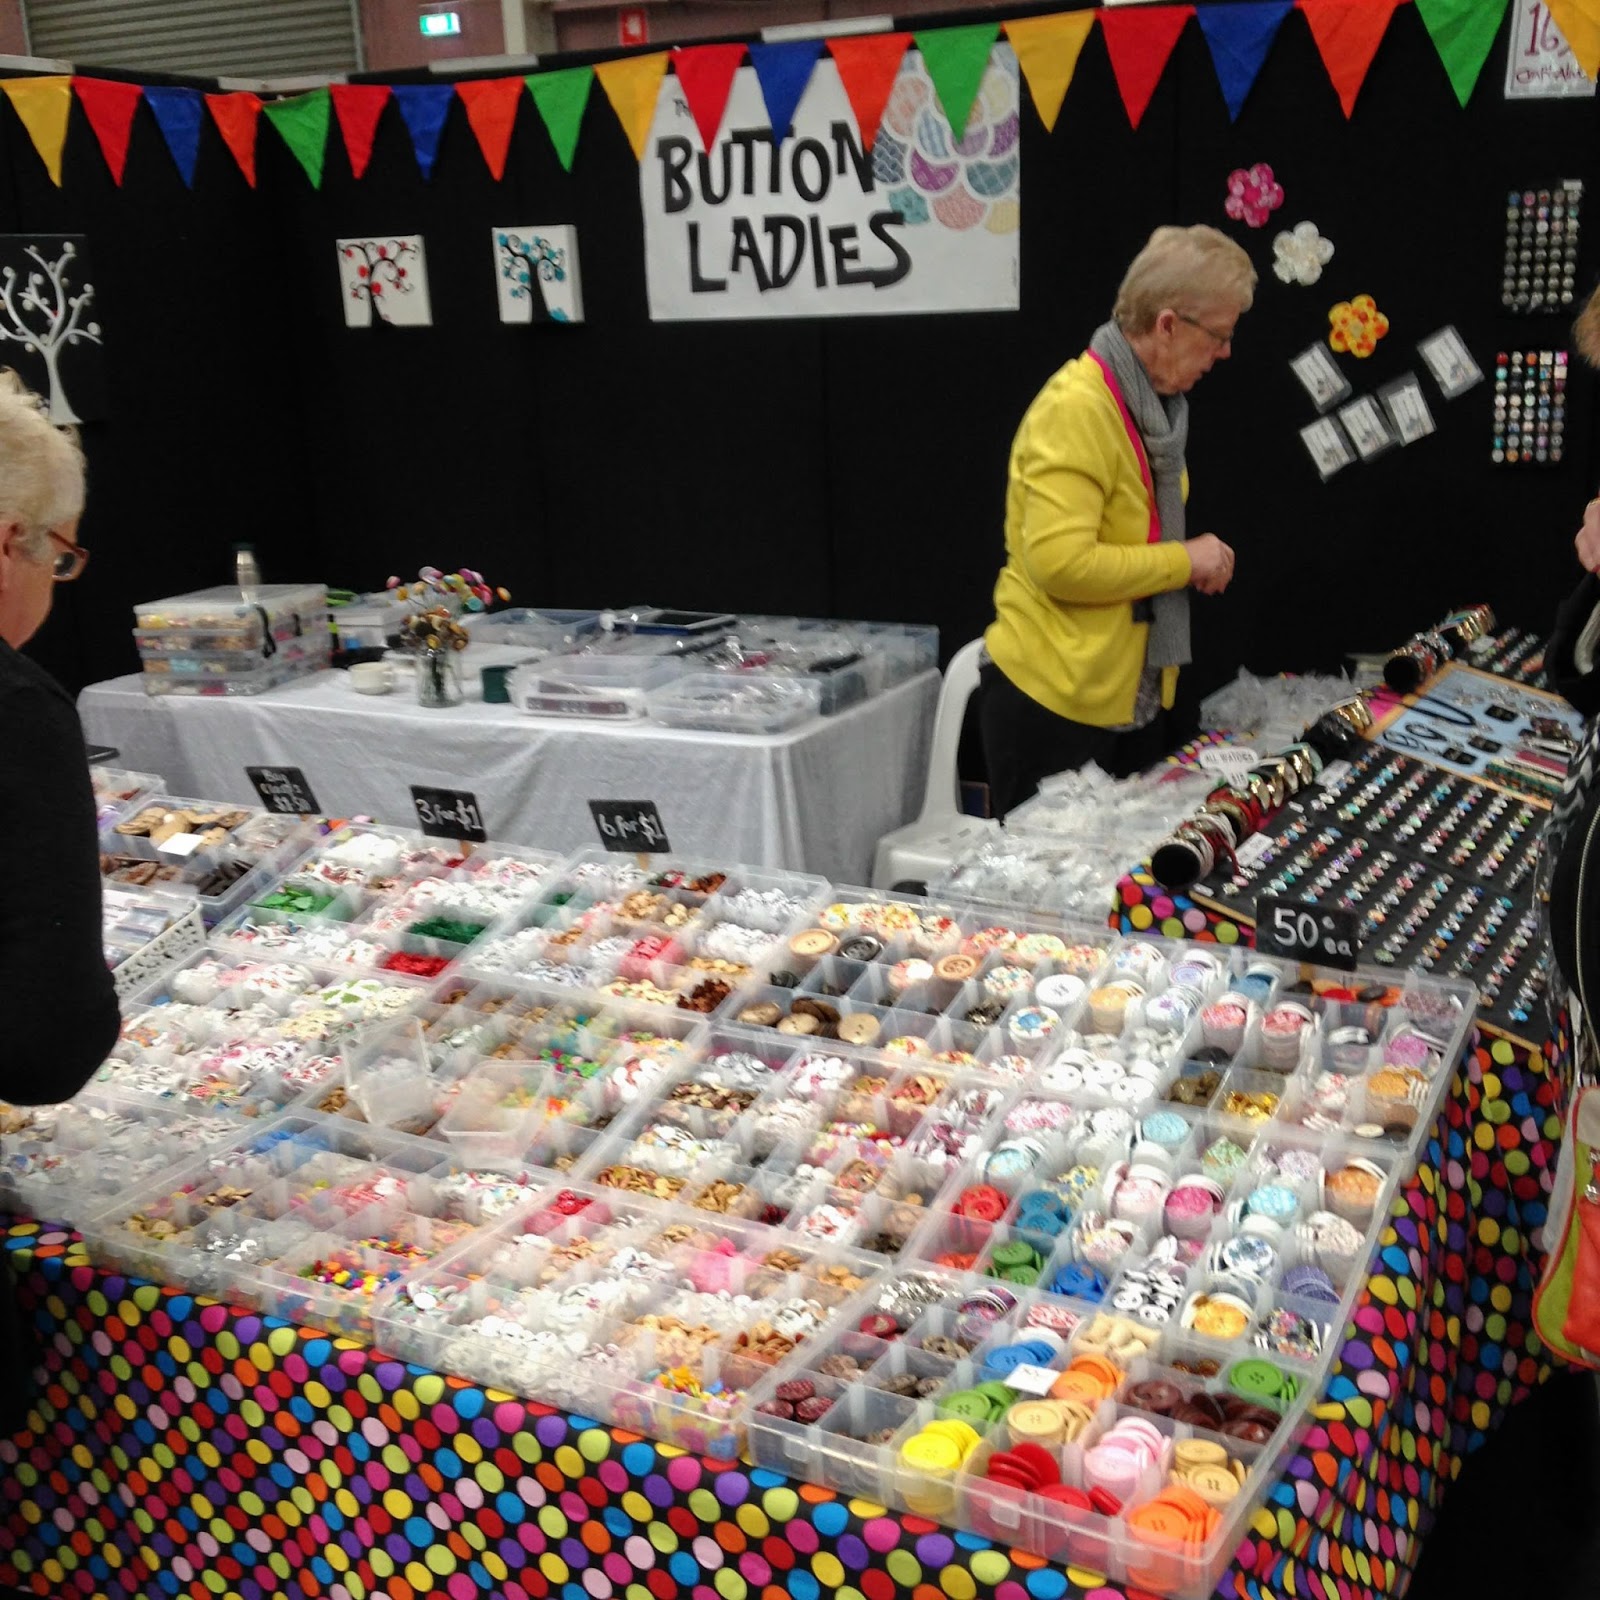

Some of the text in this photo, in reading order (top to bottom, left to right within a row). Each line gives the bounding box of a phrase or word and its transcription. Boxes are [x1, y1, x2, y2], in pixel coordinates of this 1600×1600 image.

[657, 120, 876, 214] BUTTON
[687, 210, 913, 293] LADIES
[415, 799, 436, 824] 3
[456, 799, 483, 832] $1
[599, 813, 617, 838] 6
[638, 811, 666, 845] $1
